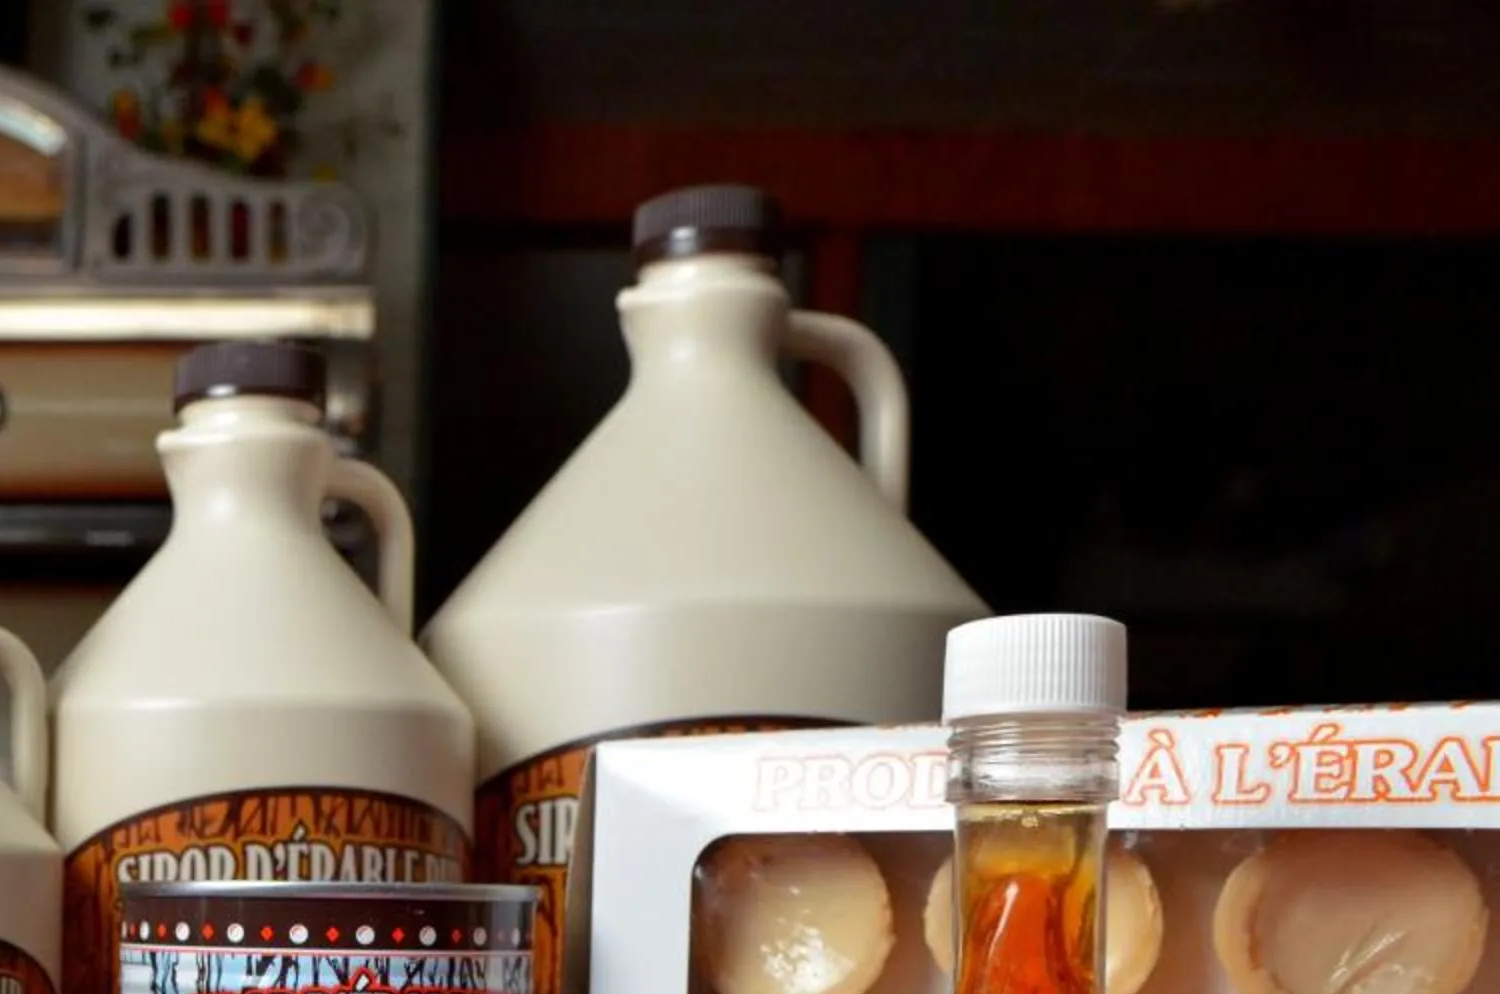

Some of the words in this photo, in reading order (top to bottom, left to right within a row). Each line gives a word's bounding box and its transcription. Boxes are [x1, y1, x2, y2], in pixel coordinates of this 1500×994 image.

[751, 752, 949, 812] PROD
[1122, 728, 1191, 806] À
[1211, 723, 1500, 806] L'ÉRA
[516, 797, 579, 866] SIR
